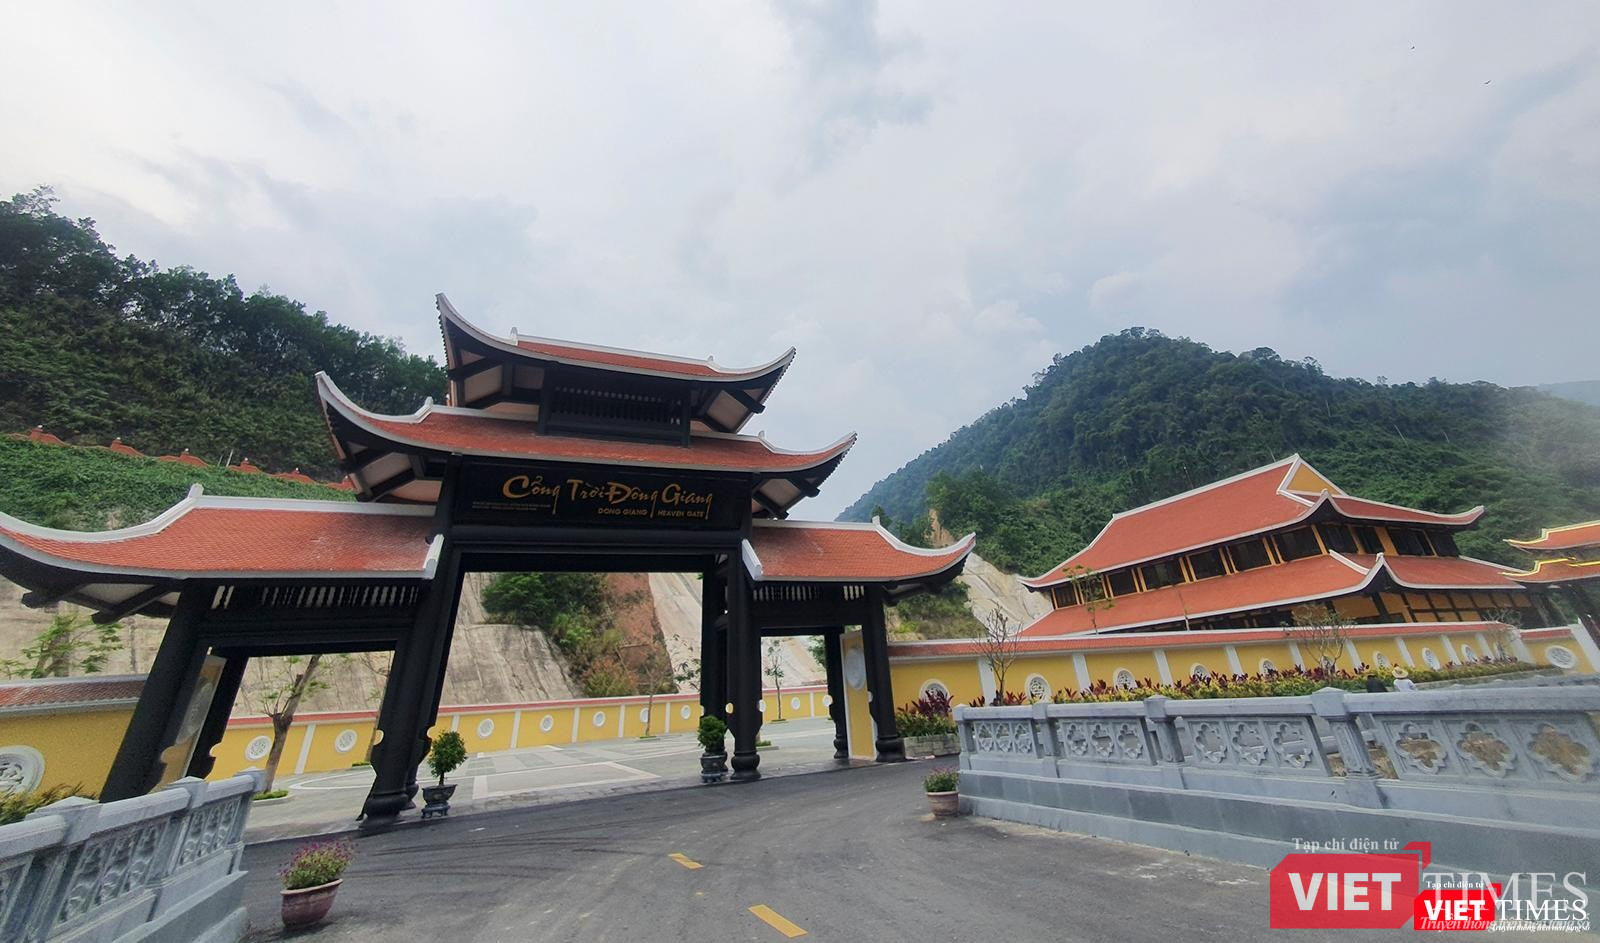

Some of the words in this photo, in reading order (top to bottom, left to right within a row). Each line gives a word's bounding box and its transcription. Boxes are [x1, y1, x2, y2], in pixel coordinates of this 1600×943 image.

[502, 475, 561, 515] Cổng
[566, 478, 606, 501] Trời
[604, 481, 659, 519] Đông
[660, 483, 714, 520] Giang
[622, 508, 649, 517] GIANG
[657, 509, 685, 518] HEAVEN
[686, 511, 705, 519] GATE
